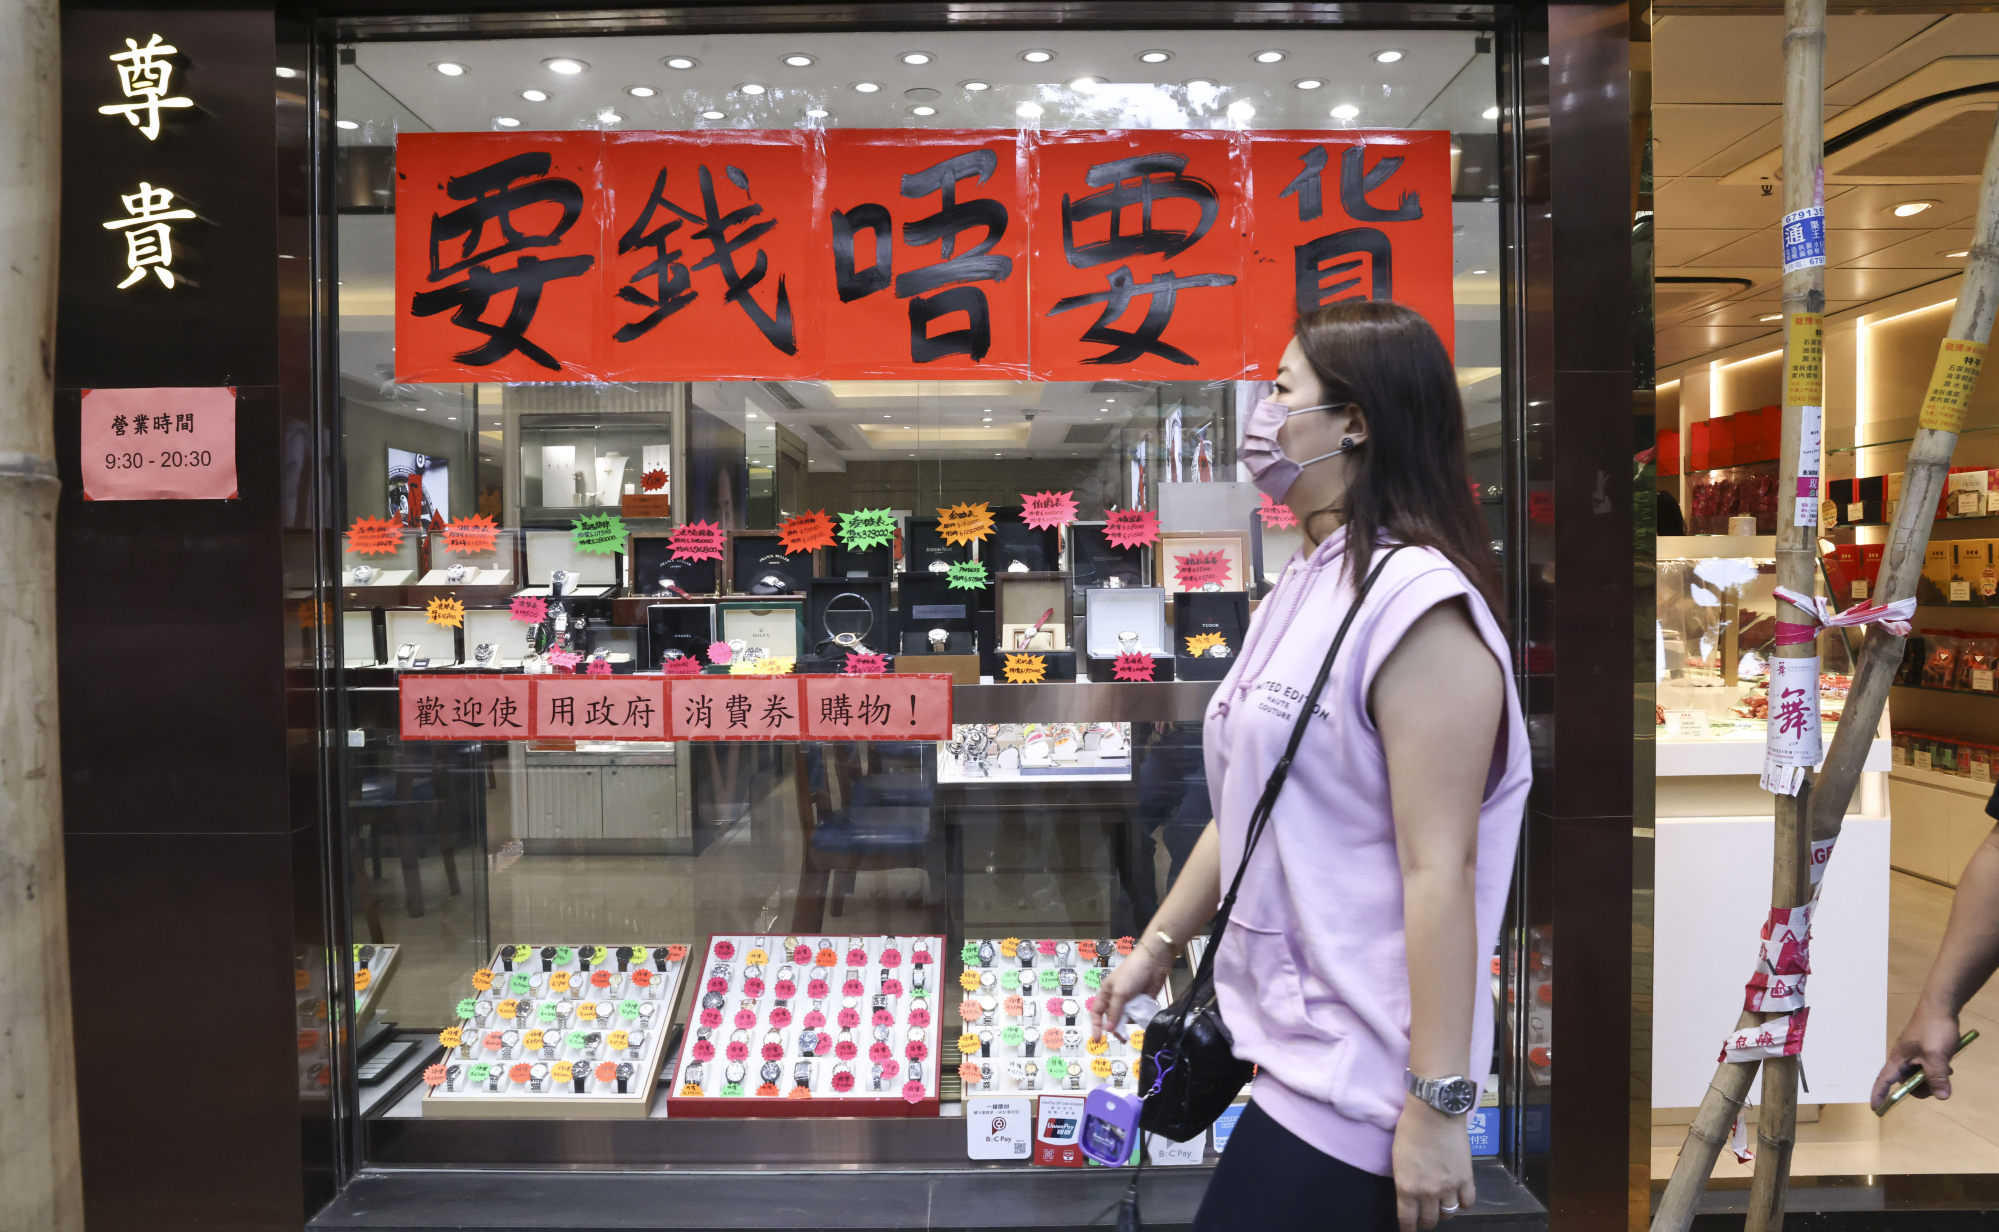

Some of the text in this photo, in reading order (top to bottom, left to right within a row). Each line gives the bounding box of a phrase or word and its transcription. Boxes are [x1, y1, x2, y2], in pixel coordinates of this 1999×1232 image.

[99, 34, 196, 289] 尊貴
[411, 144, 1425, 370] 要錢唔要貨
[111, 412, 194, 437] 營業時間
[105, 453, 143, 470] 9:30
[161, 450, 212, 468] 20:30
[1047, 1122, 1075, 1130] UnionPay
[1177, 1149, 1192, 1159] Pay
